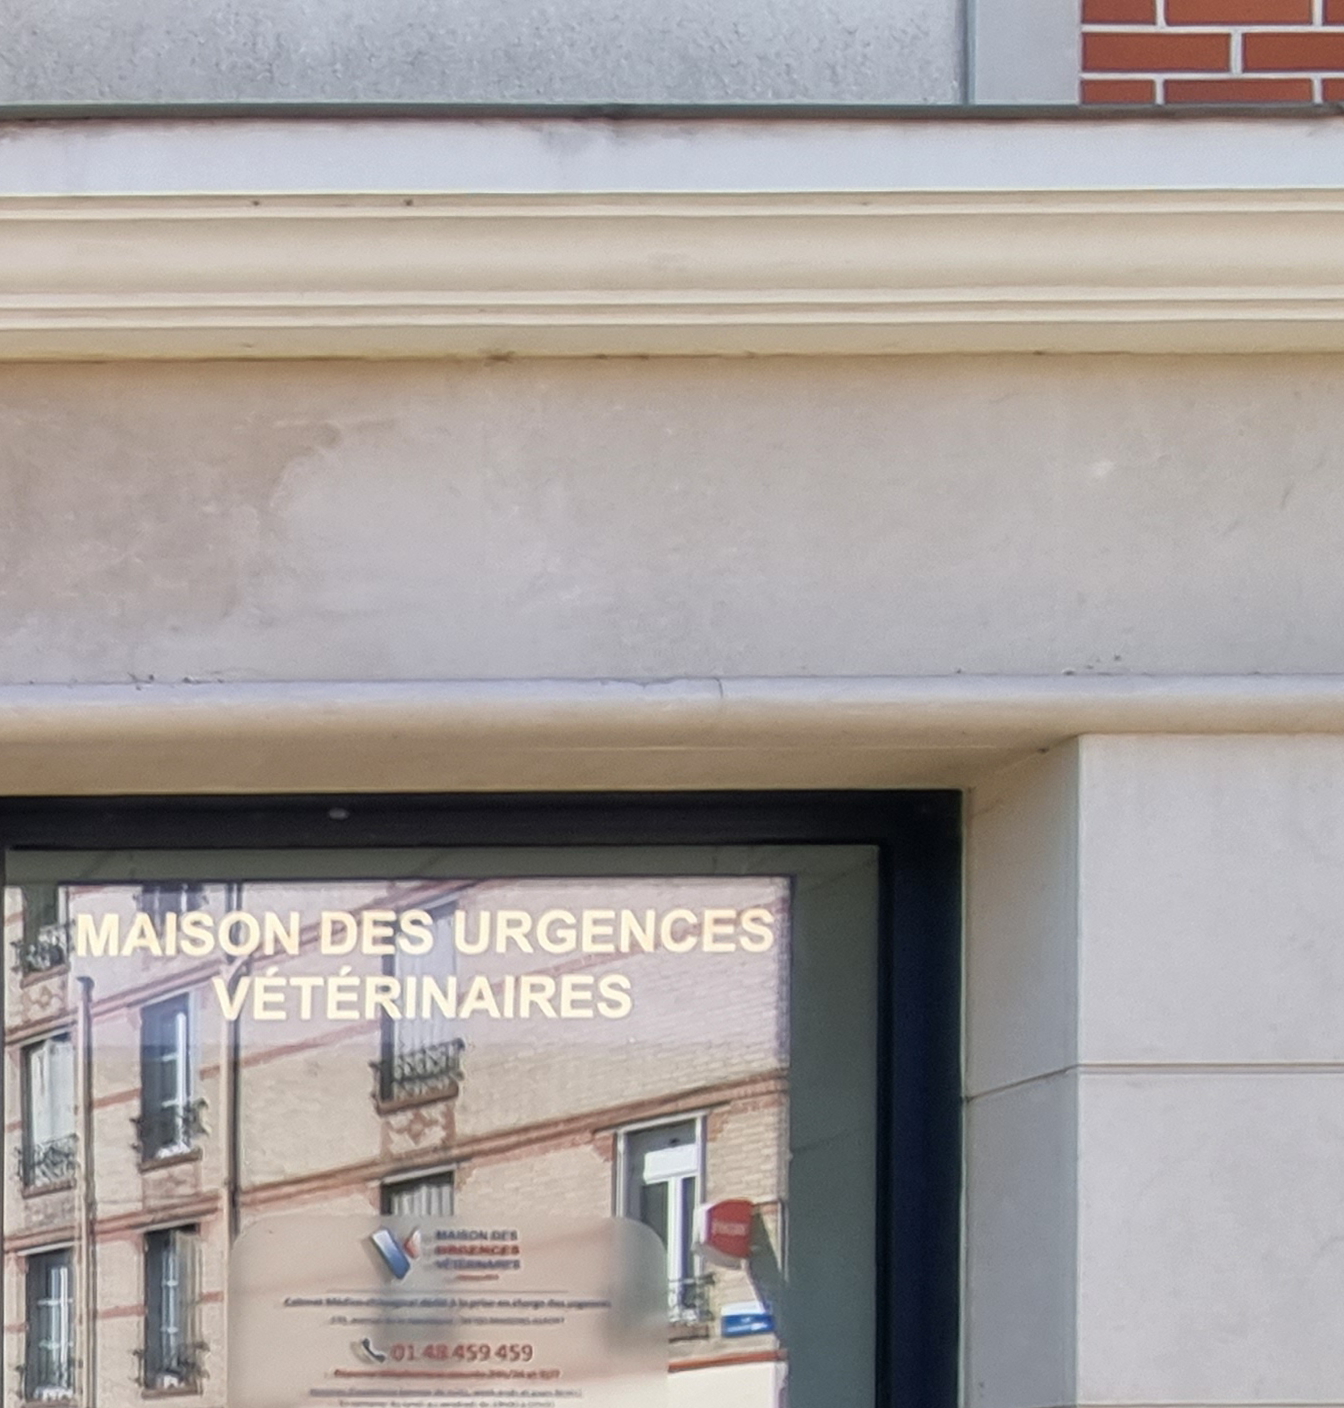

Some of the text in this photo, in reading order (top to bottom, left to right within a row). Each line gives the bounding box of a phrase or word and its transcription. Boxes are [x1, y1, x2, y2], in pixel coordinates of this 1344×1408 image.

[75, 908, 776, 957] MAISON DES URGENCES
[212, 966, 634, 1021] VÉTÉRINAIRES
[435, 1230, 518, 1241] MAISON DES
[391, 1343, 533, 1362] 01 48 459 459
